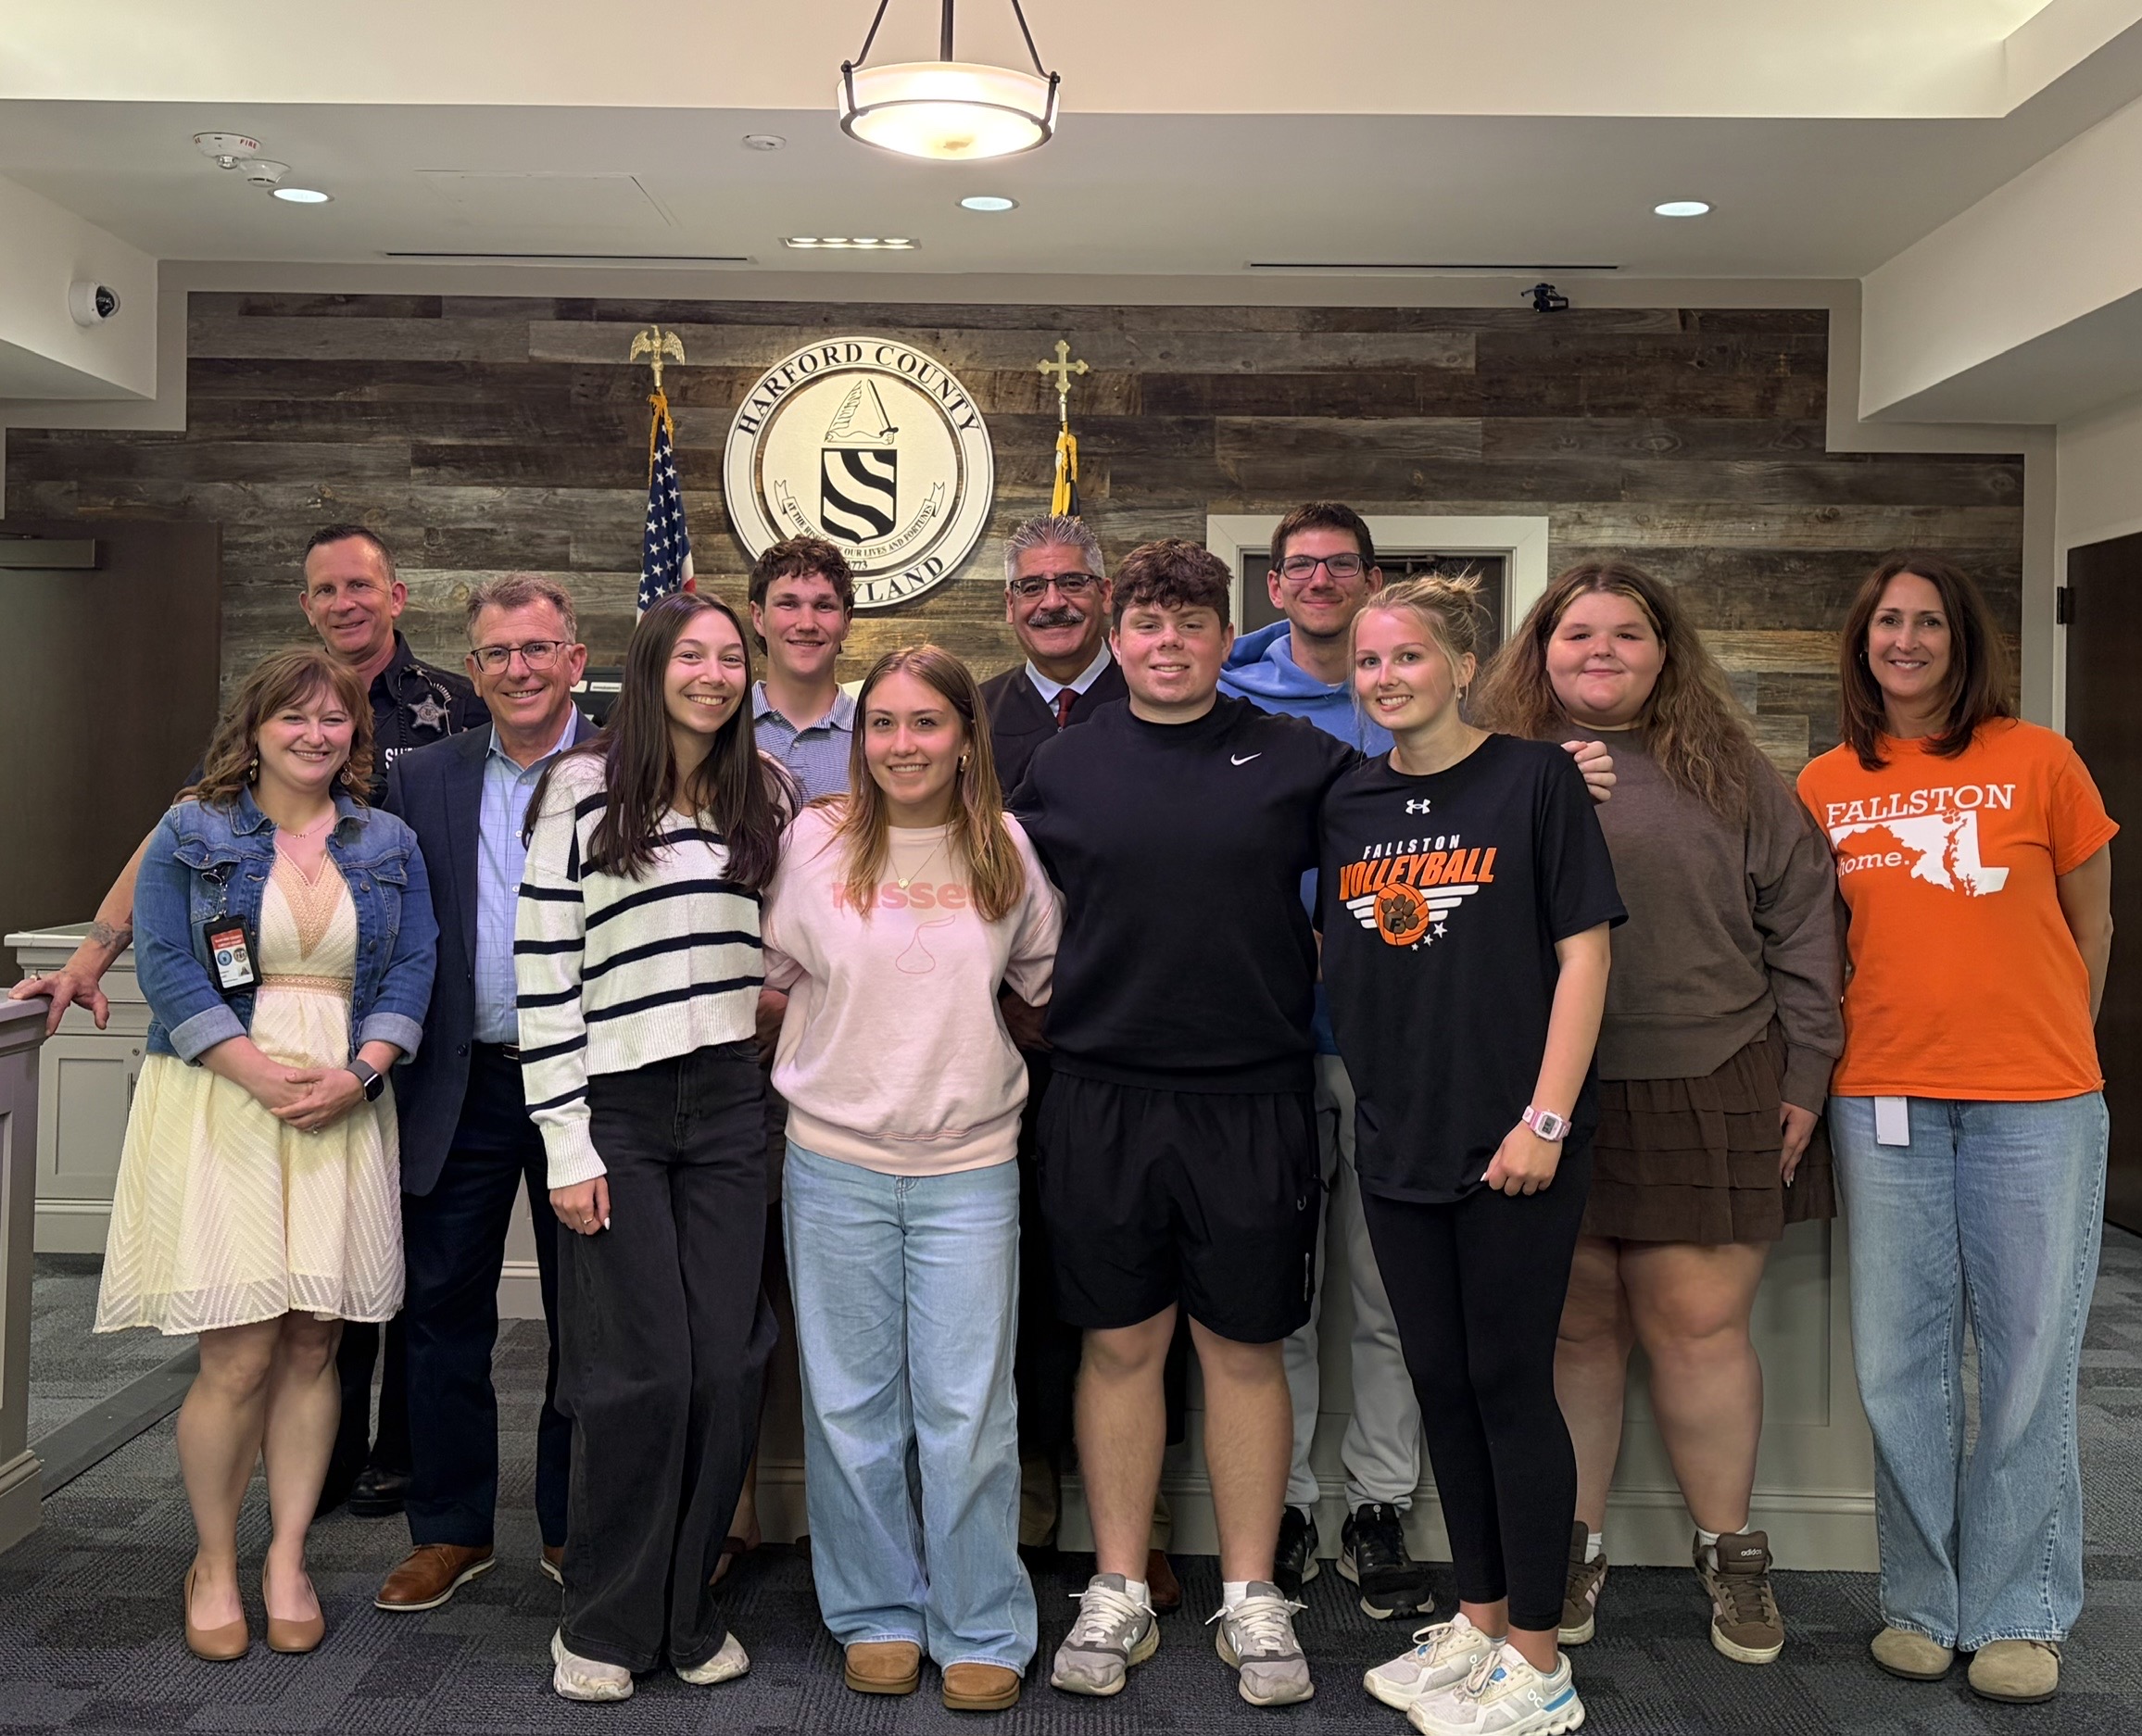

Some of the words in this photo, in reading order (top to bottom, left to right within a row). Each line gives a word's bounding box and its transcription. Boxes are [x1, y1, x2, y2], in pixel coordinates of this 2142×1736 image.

[240, 139, 257, 149] FIRE
[737, 343, 863, 437] HARFORD
[876, 346, 980, 432] COUNTY
[788, 502, 797, 511] AT
[793, 511, 807, 528] THE
[844, 547, 863, 557] OUR
[864, 547, 887, 557] LIVES
[888, 538, 904, 551] AND
[903, 504, 933, 540] FORTUNES
[850, 557, 943, 602] YLAND
[1826, 784, 2016, 827] FALLSTON
[1362, 834, 1460, 860] FALLSTON
[1837, 851, 1909, 878] home.
[1339, 847, 1497, 901] VOLLEYBALL
